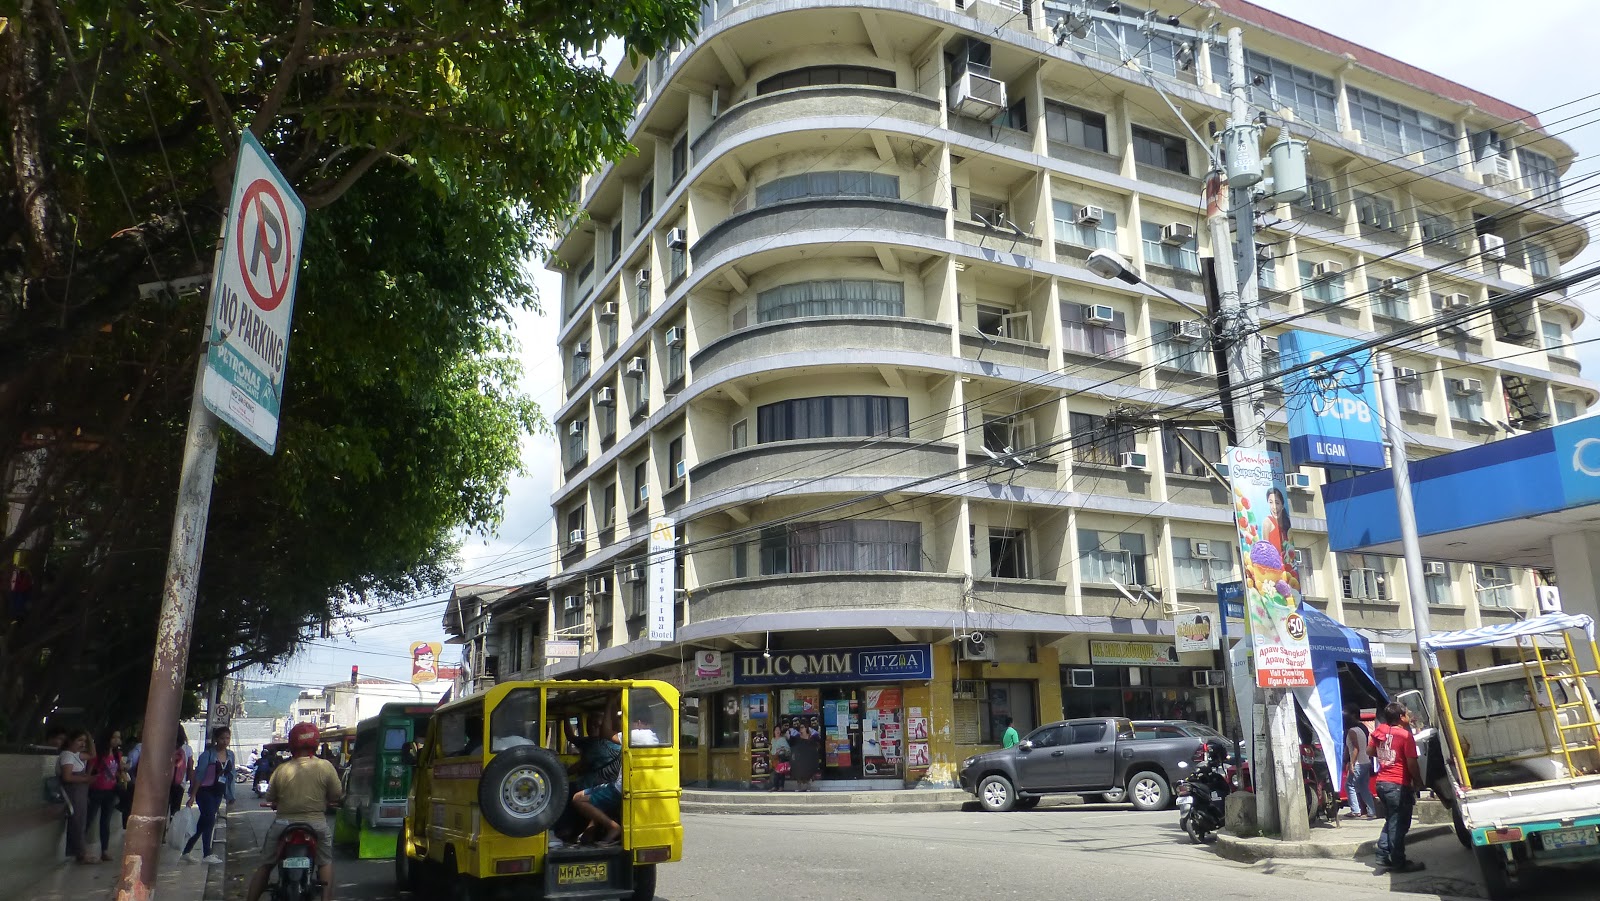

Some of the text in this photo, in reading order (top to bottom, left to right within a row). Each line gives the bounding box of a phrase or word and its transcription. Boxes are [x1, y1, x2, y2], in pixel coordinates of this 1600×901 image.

[219, 283, 284, 373] NO PARKING
[217, 345, 261, 390] PETRONAS
[1312, 393, 1371, 423] UCPB
[1316, 442, 1345, 457] ILIGAN
[1259, 647, 1279, 657] Apaw
[1265, 656, 1306, 667] Apaw Sarap!
[1269, 669, 1305, 678] Visit Chowking
[1282, 677, 1309, 686] Aguinaldo
[559, 867, 580, 878] MHA
